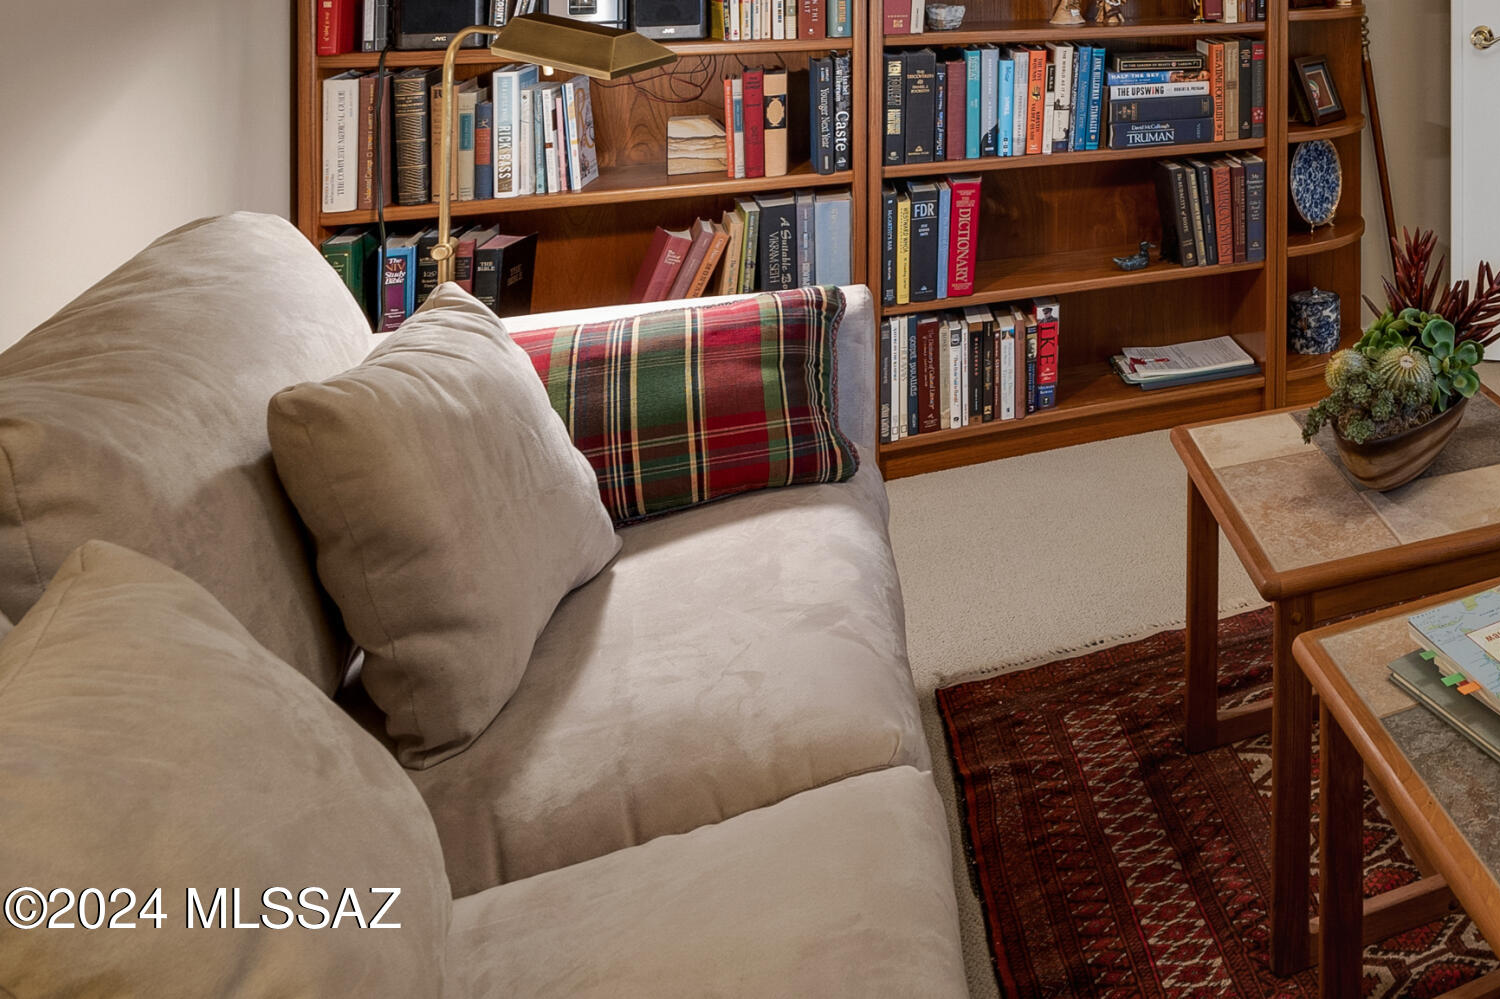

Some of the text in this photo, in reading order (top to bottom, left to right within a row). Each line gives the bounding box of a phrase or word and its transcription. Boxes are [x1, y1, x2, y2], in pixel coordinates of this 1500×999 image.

[811, 8, 819, 22] THE
[887, 60, 902, 76] KEN
[1094, 57, 1102, 71] ANNE
[835, 69, 843, 102] Wilkerson
[1092, 71, 1101, 100] HILLERMAN
[1117, 87, 1130, 97] THE
[1131, 85, 1165, 96] UPSWING
[819, 88, 831, 148] Younger Next Year
[835, 111, 850, 152] Caste
[1126, 130, 1175, 144] TRUMAN
[499, 126, 512, 179] RICK BASS
[1177, 181, 1186, 209] AUDACITY
[914, 202, 936, 218] FDR
[768, 231, 780, 282] VIKRAM SETH
[780, 217, 792, 289] A Suitable Bo
[955, 207, 971, 283] DICTIONARY
[384, 270, 406, 278] Study
[385, 263, 405, 271] NIV
[385, 277, 404, 285] Bible
[688, 263, 712, 298] MONTAN
[1040, 325, 1056, 365] IKE
